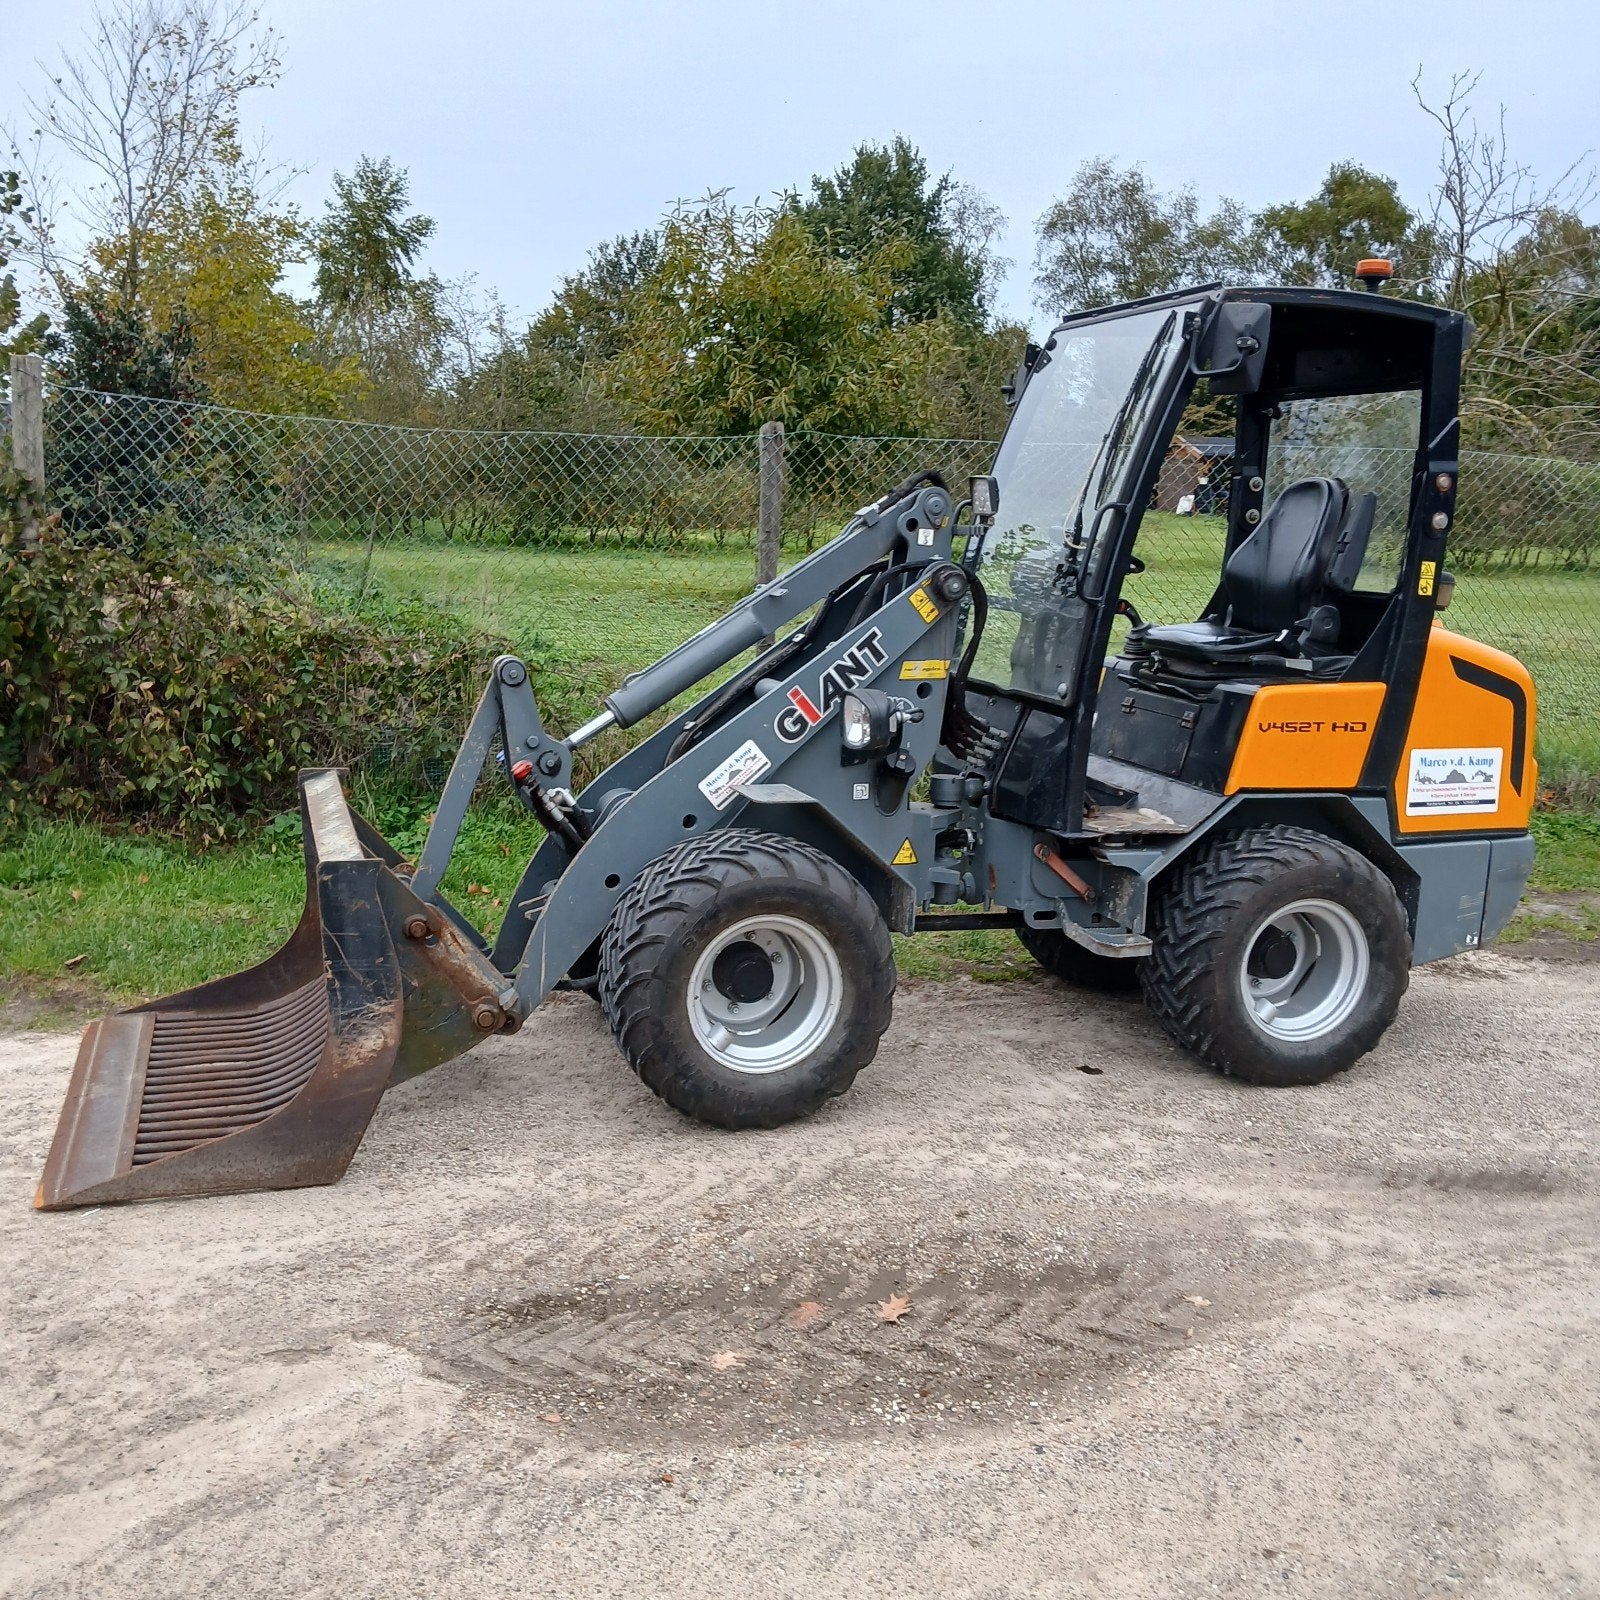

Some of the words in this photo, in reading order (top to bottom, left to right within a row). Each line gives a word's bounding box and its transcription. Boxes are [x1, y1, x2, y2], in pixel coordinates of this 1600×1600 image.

[1258, 721, 1325, 733] V452T
[1331, 721, 1367, 732] HD
[1420, 757, 1447, 767] Marco
[1450, 756, 1466, 767] v.d.
[1469, 755, 1494, 768] Kamp
